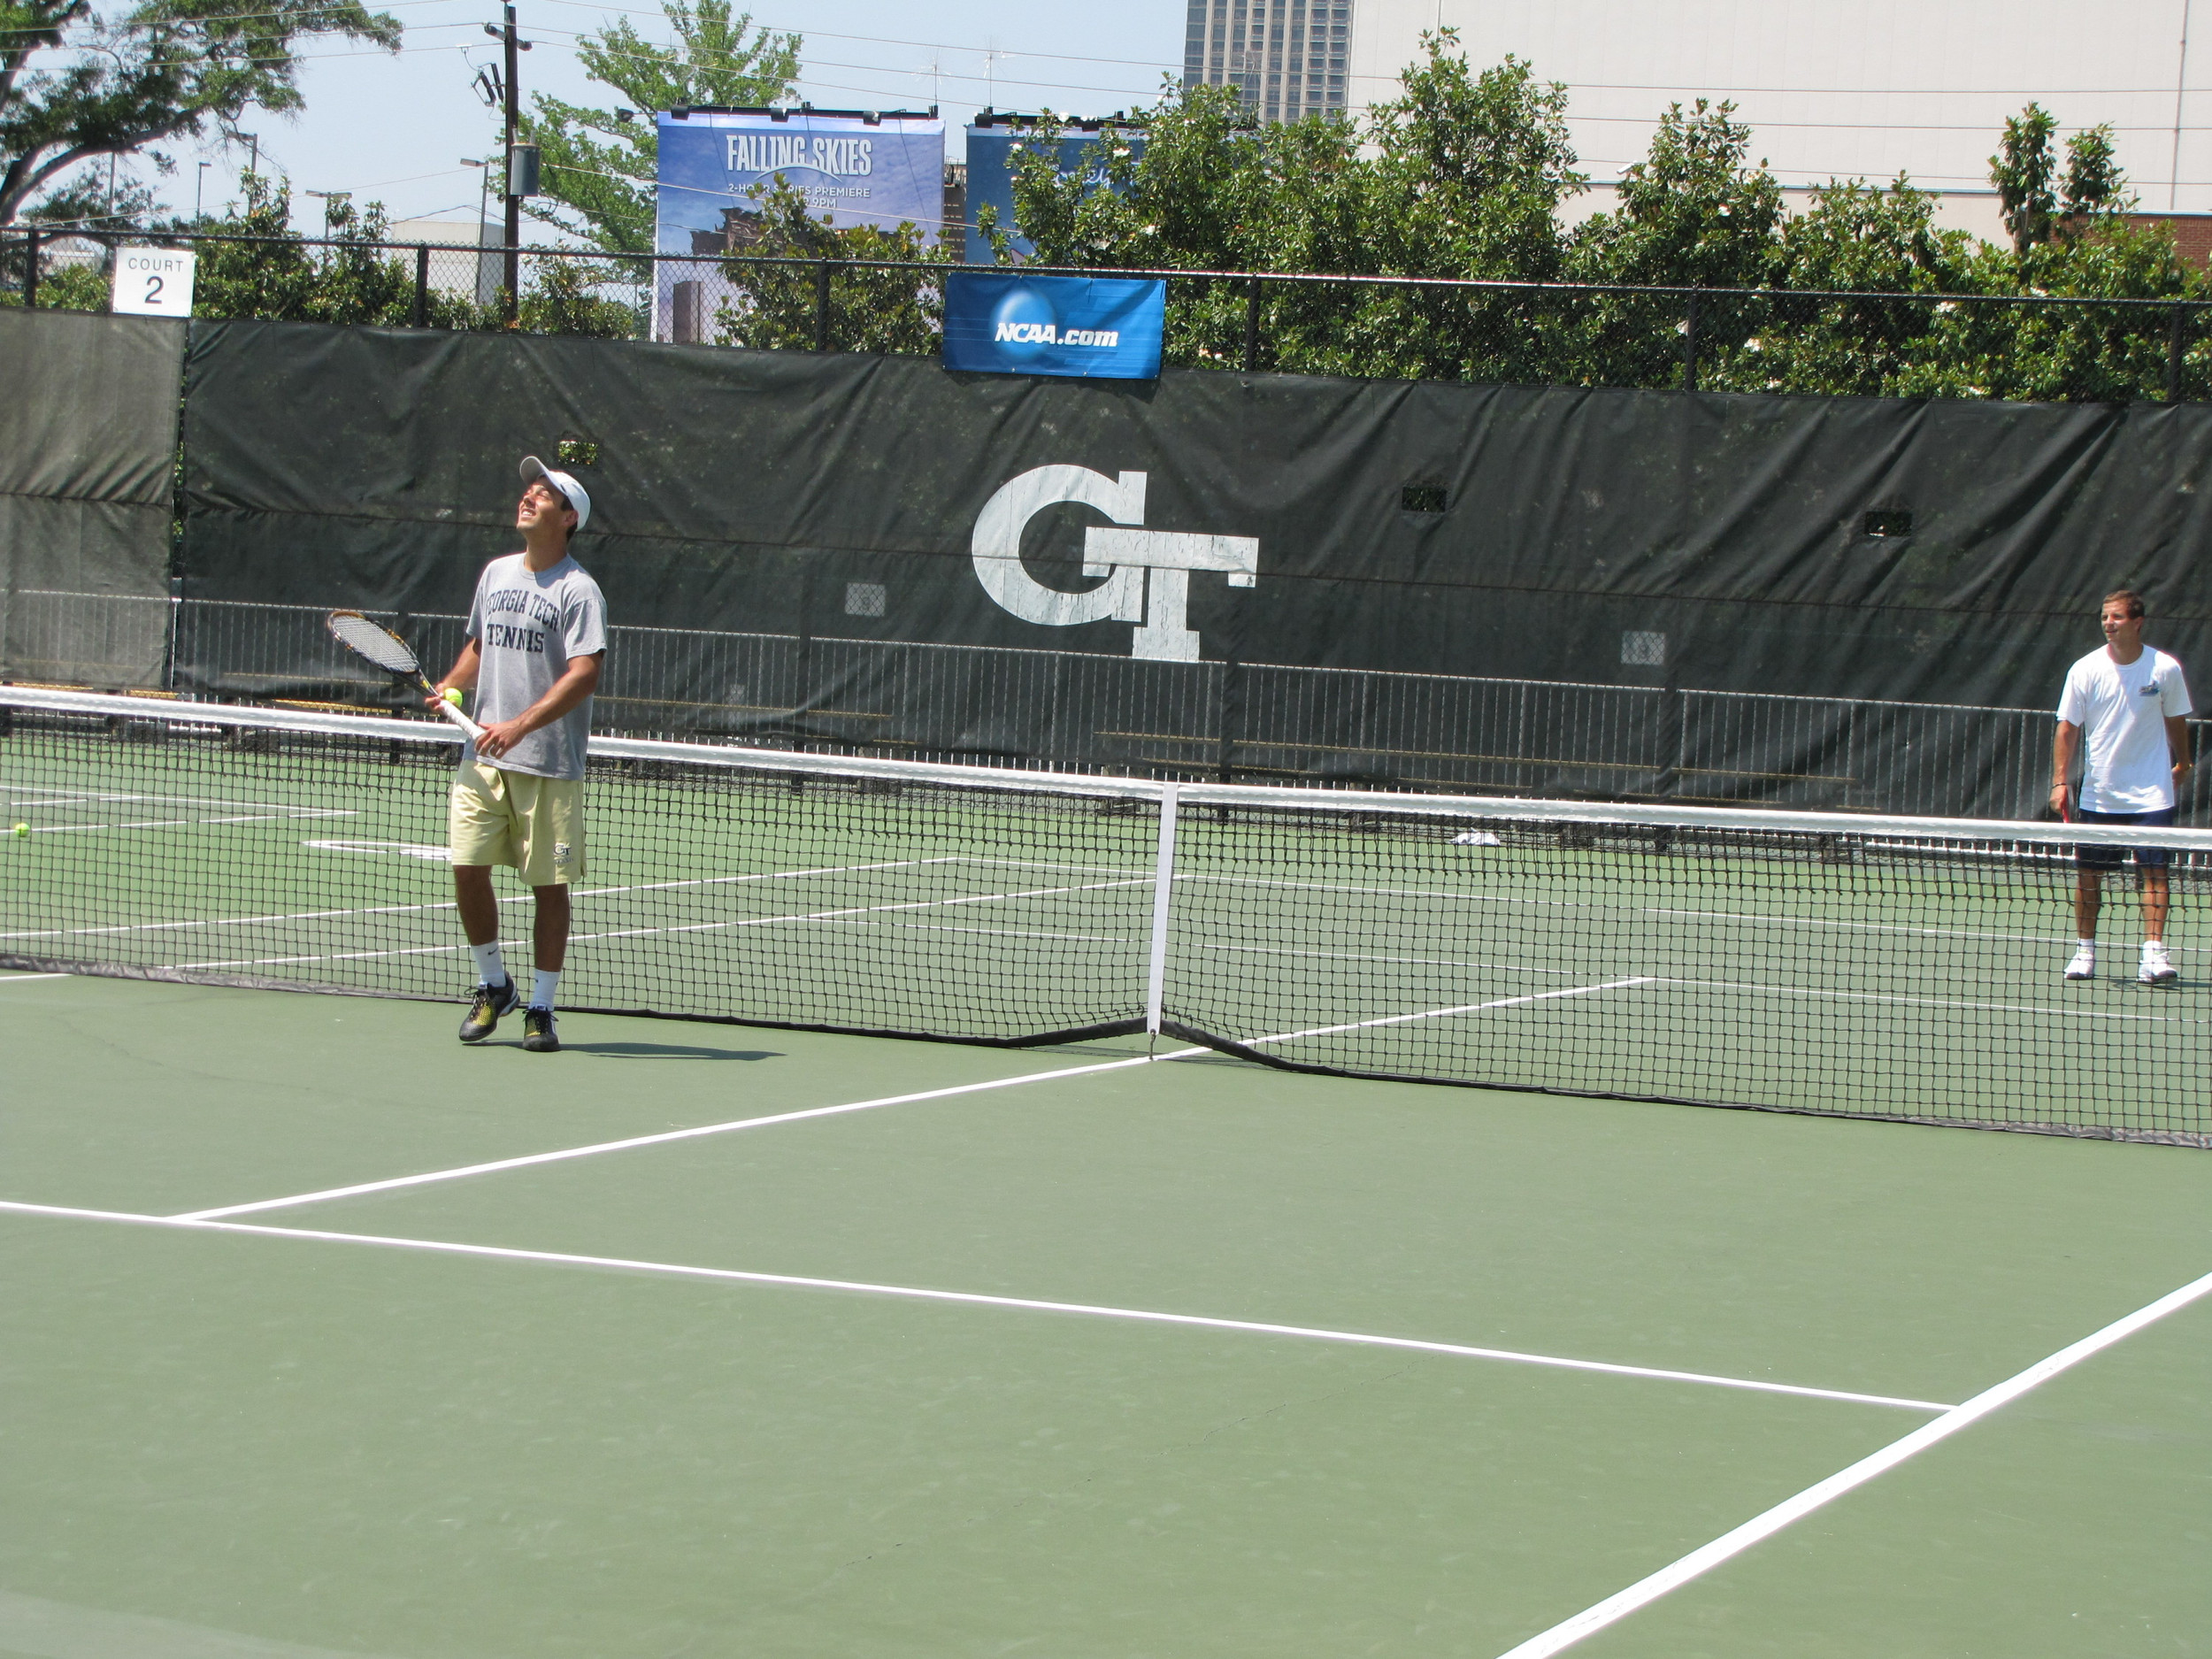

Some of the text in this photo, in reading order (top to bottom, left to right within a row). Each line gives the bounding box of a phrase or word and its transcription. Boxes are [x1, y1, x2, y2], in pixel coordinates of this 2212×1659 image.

[726, 134, 872, 176] FALLING SKIES
[728, 183, 871, 197] 2-HOR SRIES PREMIERE
[812, 197, 837, 208] 9PM
[128, 257, 183, 272] COURT
[144, 275, 164, 304] 2
[995, 323, 1118, 347] NCAA.com
[972, 464, 1259, 664] GT
[529, 594, 560, 632] TECH
[488, 624, 544, 652] TENNIS
